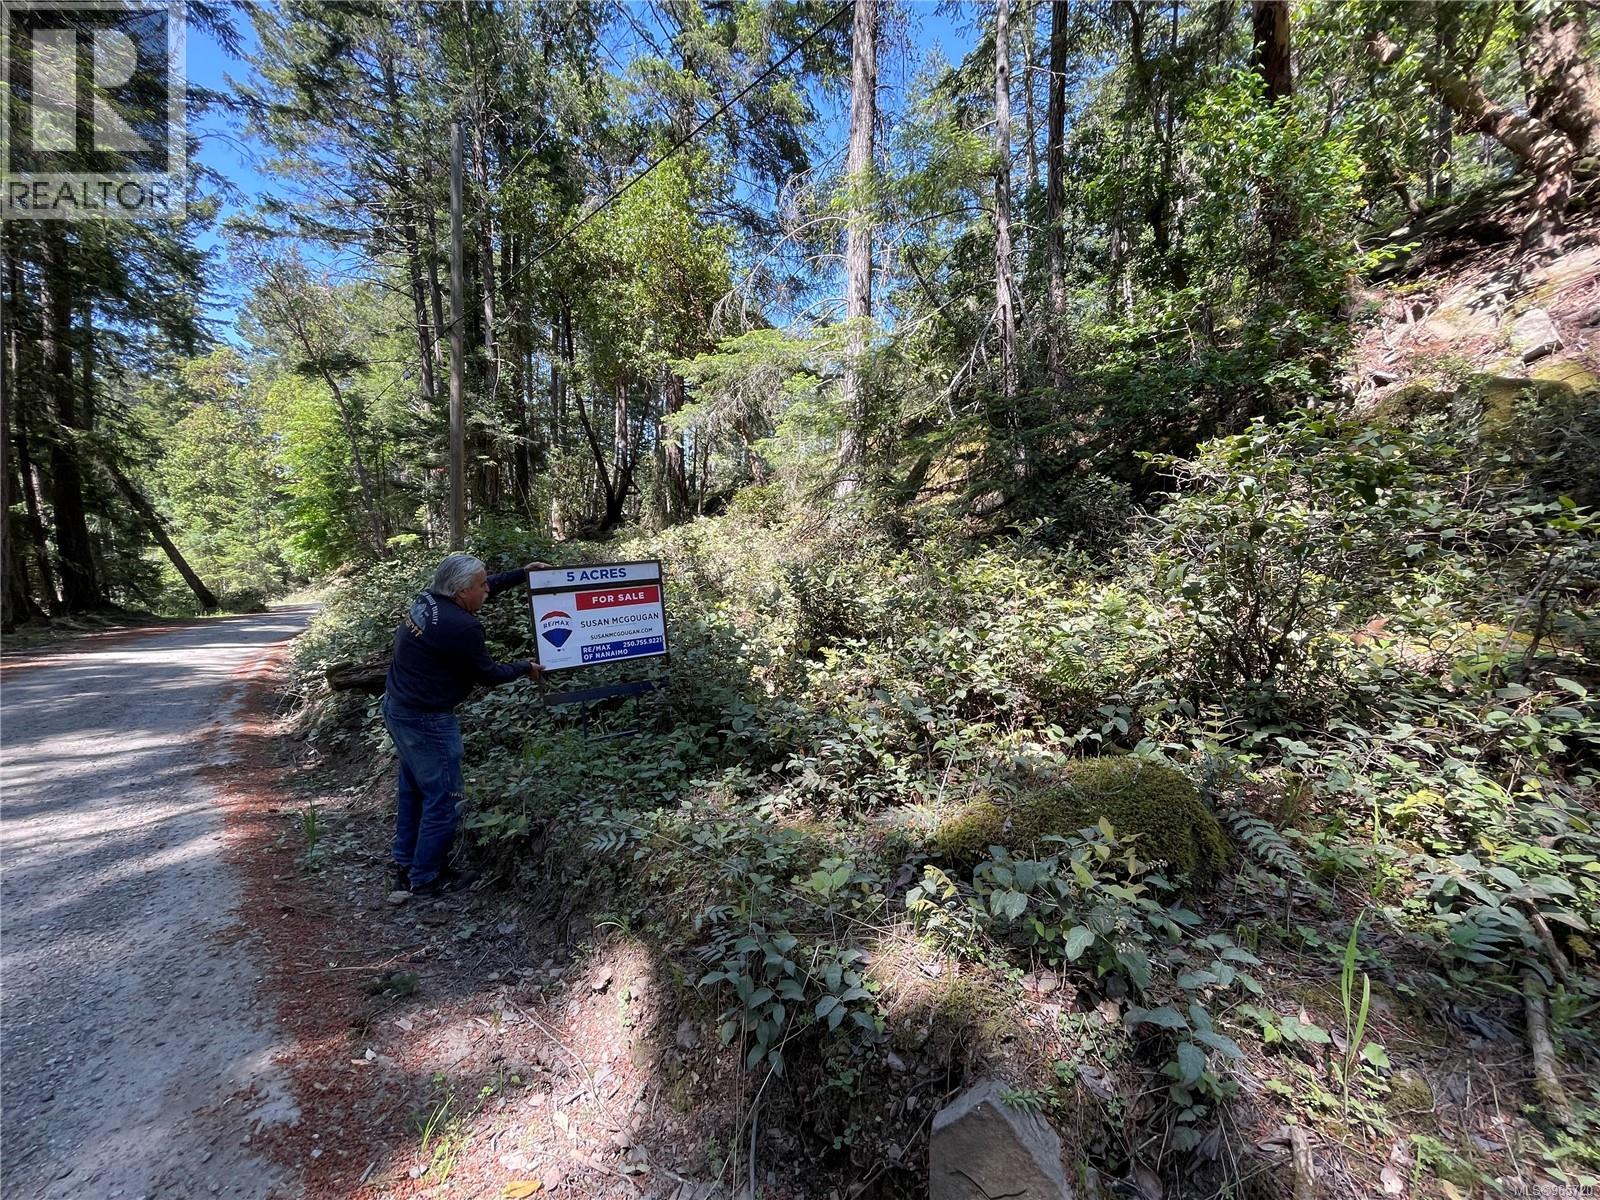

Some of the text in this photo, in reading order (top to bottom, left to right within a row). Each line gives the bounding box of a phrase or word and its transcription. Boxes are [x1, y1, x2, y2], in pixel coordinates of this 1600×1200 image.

[567, 567, 627, 582] 5 ACRES
[592, 591, 645, 604] FOR SALE
[543, 620, 570, 629] RE/MAX
[580, 612, 659, 628] SUSAN MCGOUGAN
[590, 627, 653, 640] SUSANMCGOUGAN.COM
[582, 644, 611, 653] RE/MAX
[623, 637, 662, 647] 250.755.9221
[583, 653, 593, 661] OF
[595, 648, 628, 659] NANAIMO
